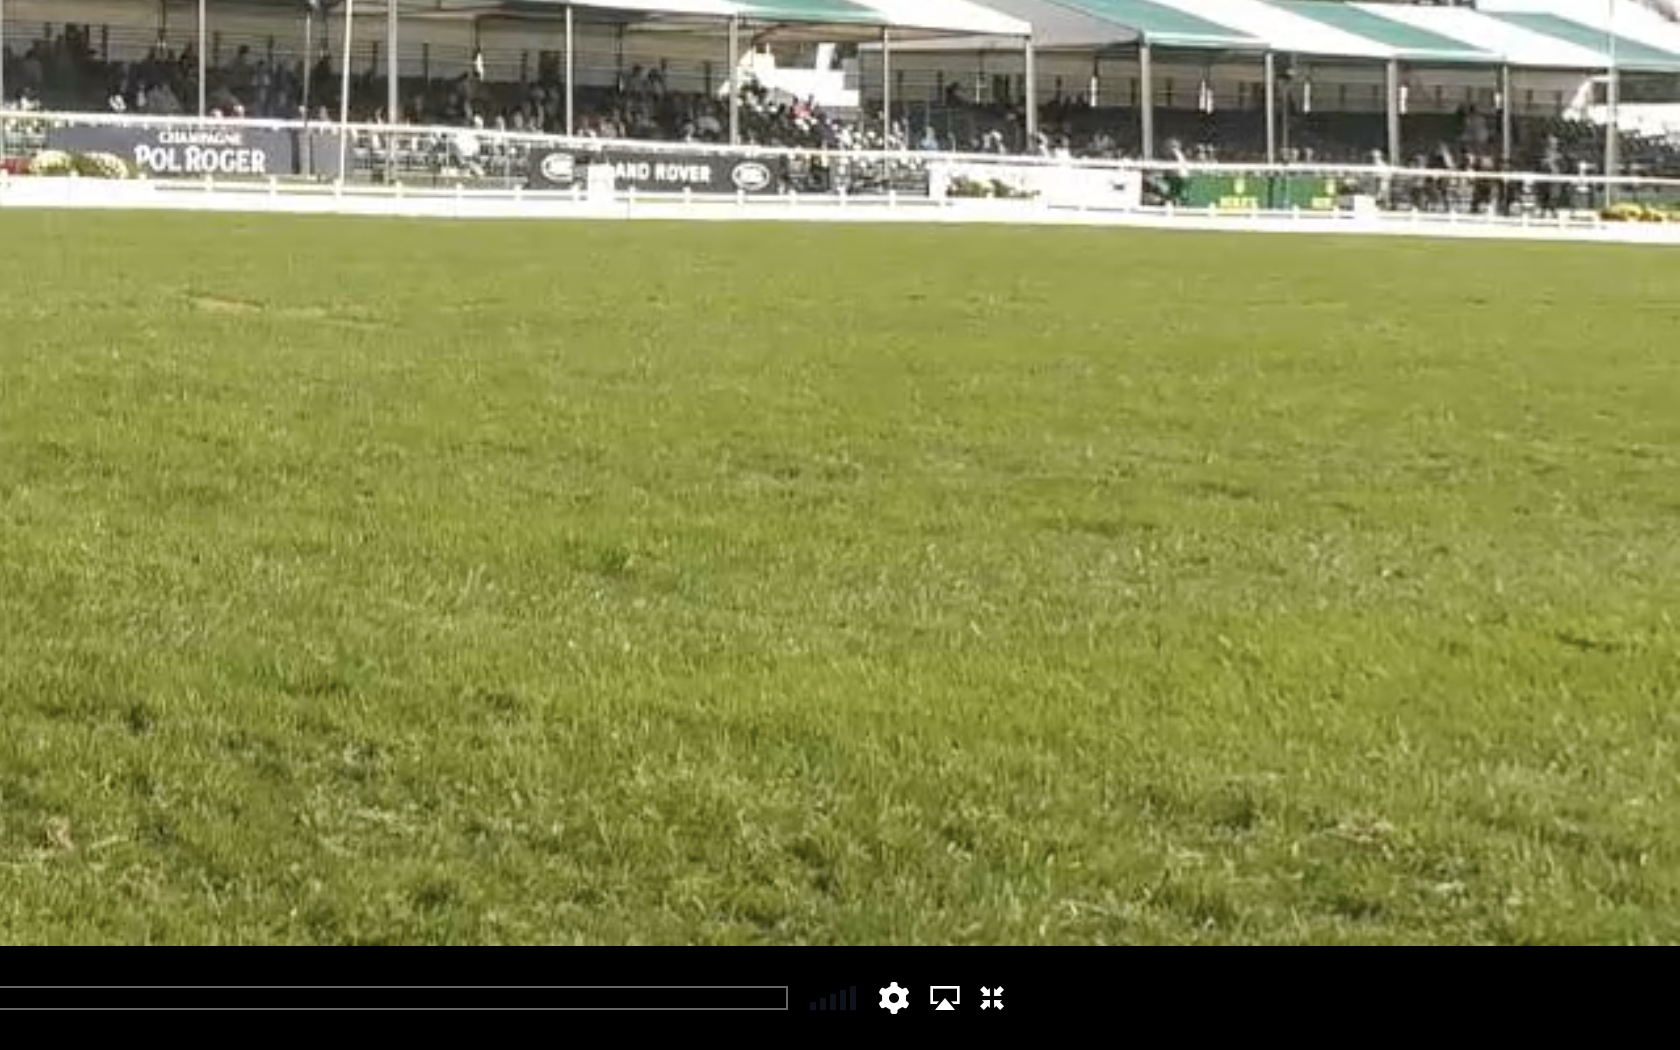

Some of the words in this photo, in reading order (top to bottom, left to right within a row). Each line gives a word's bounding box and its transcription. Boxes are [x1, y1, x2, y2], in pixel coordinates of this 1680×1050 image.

[159, 131, 243, 146] CHAMPAGNE
[133, 144, 182, 173] POL
[184, 145, 267, 174] ROGER
[613, 161, 651, 181] AND
[655, 163, 712, 183] ROVER
